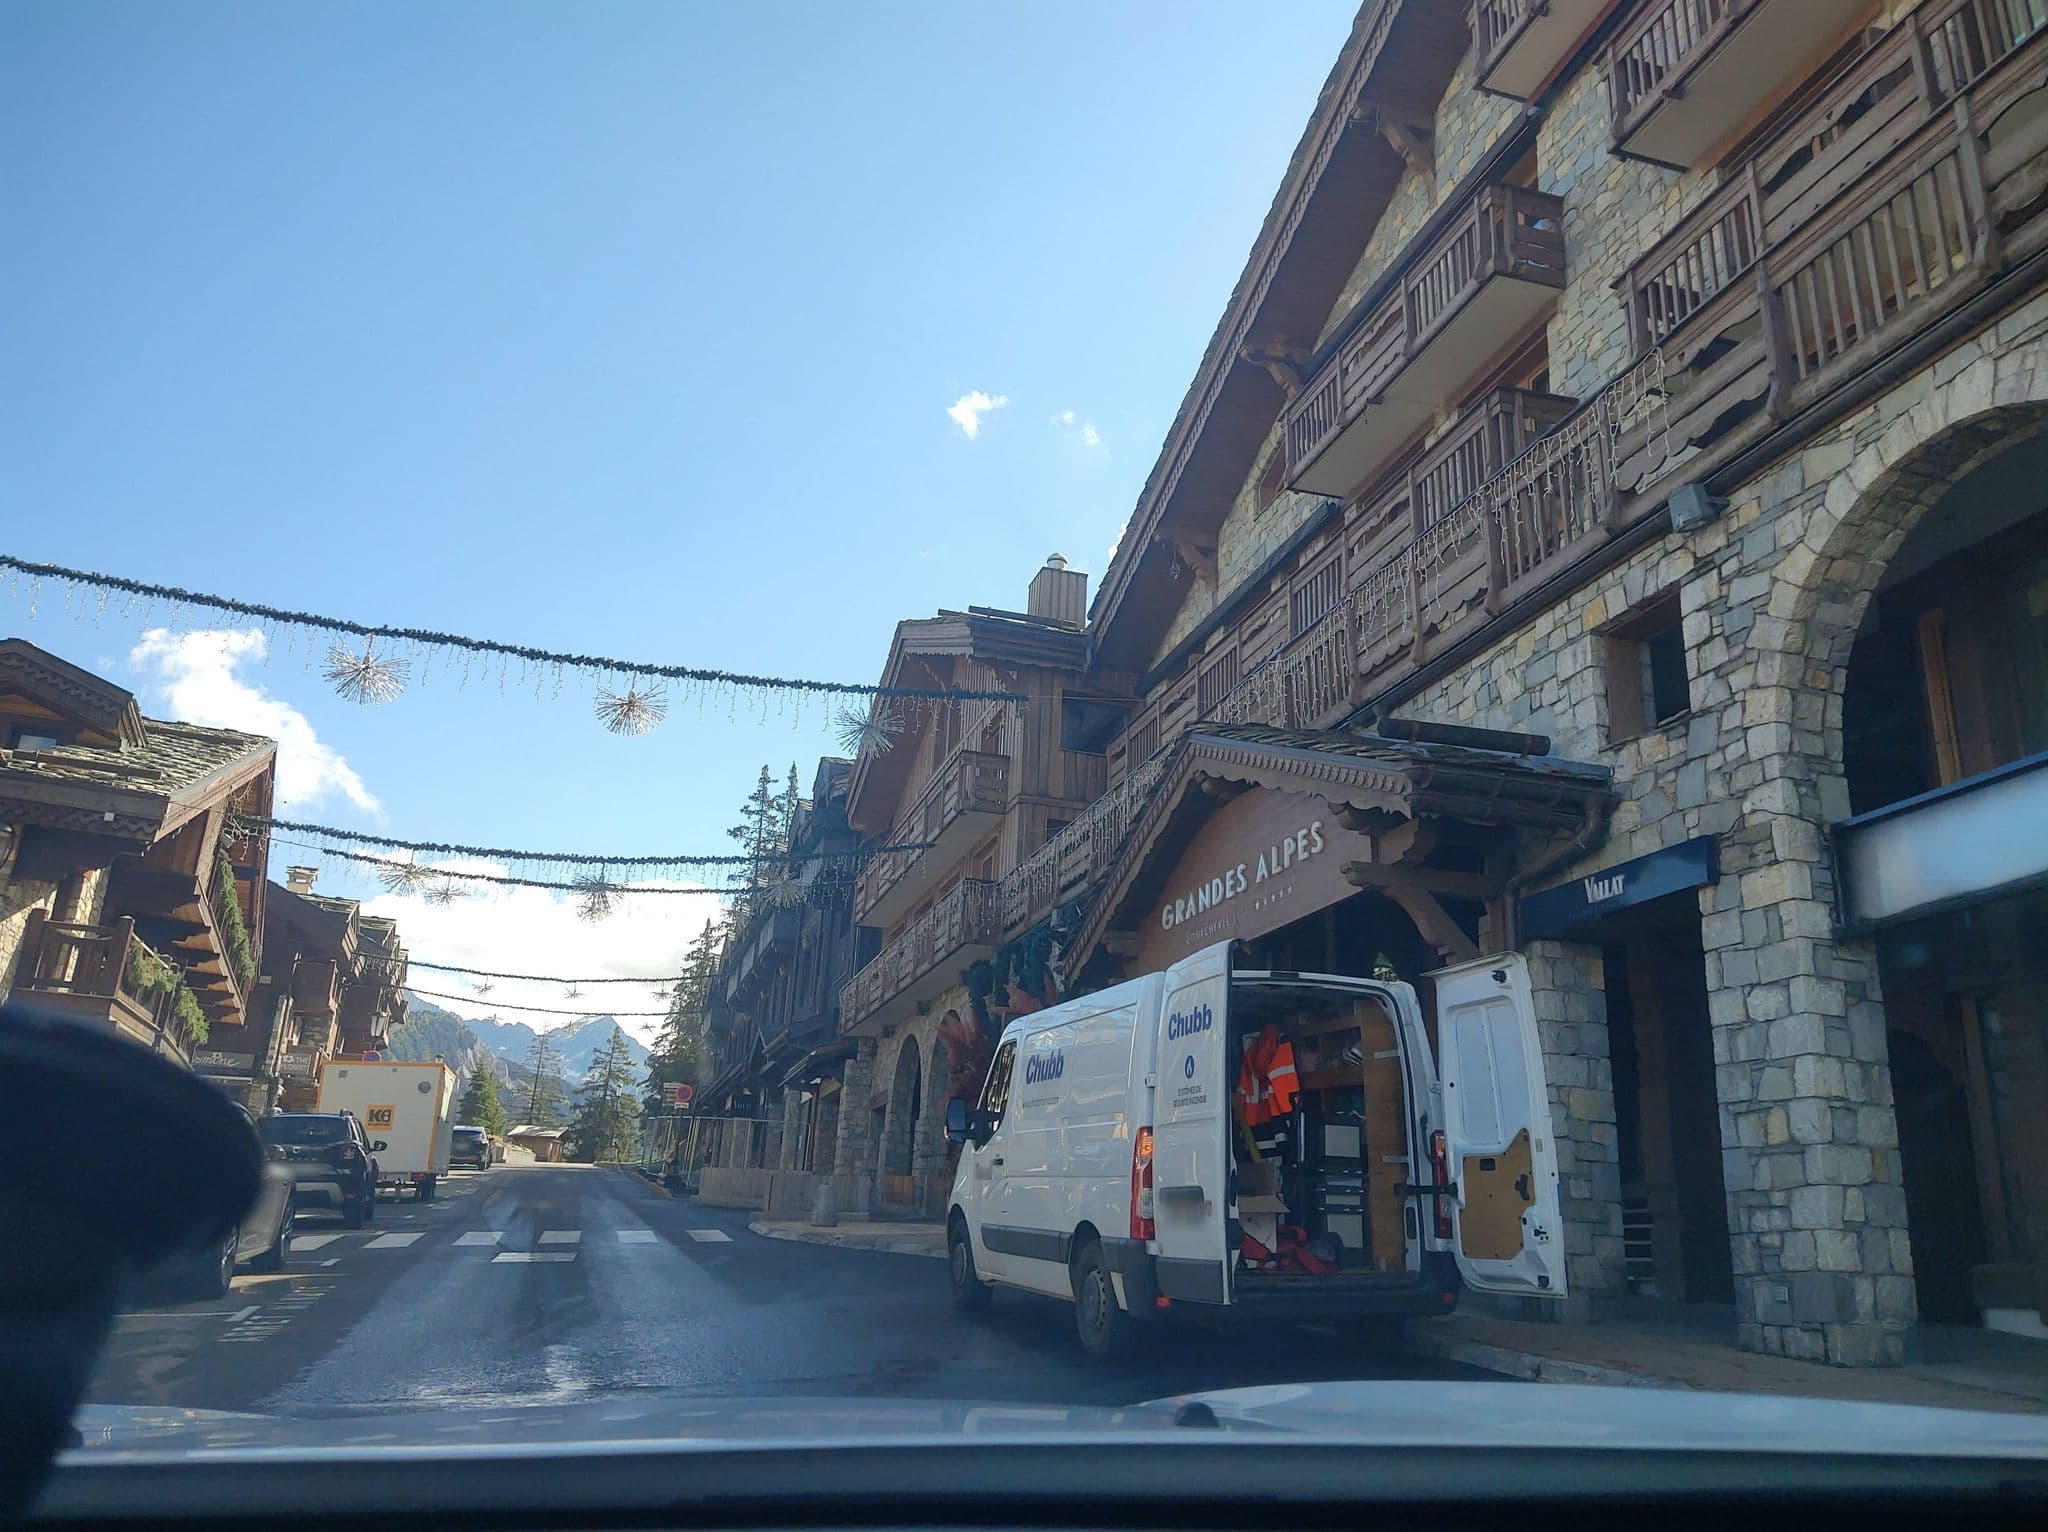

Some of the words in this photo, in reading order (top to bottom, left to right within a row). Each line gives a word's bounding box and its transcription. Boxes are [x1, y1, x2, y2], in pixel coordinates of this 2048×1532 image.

[1161, 863, 1249, 931] GRANDES
[1255, 820, 1325, 884] ALPES
[1168, 1003, 1213, 1042] Chubb
[296, 1056, 309, 1064] THE
[1025, 1048, 1065, 1085] Chubb
